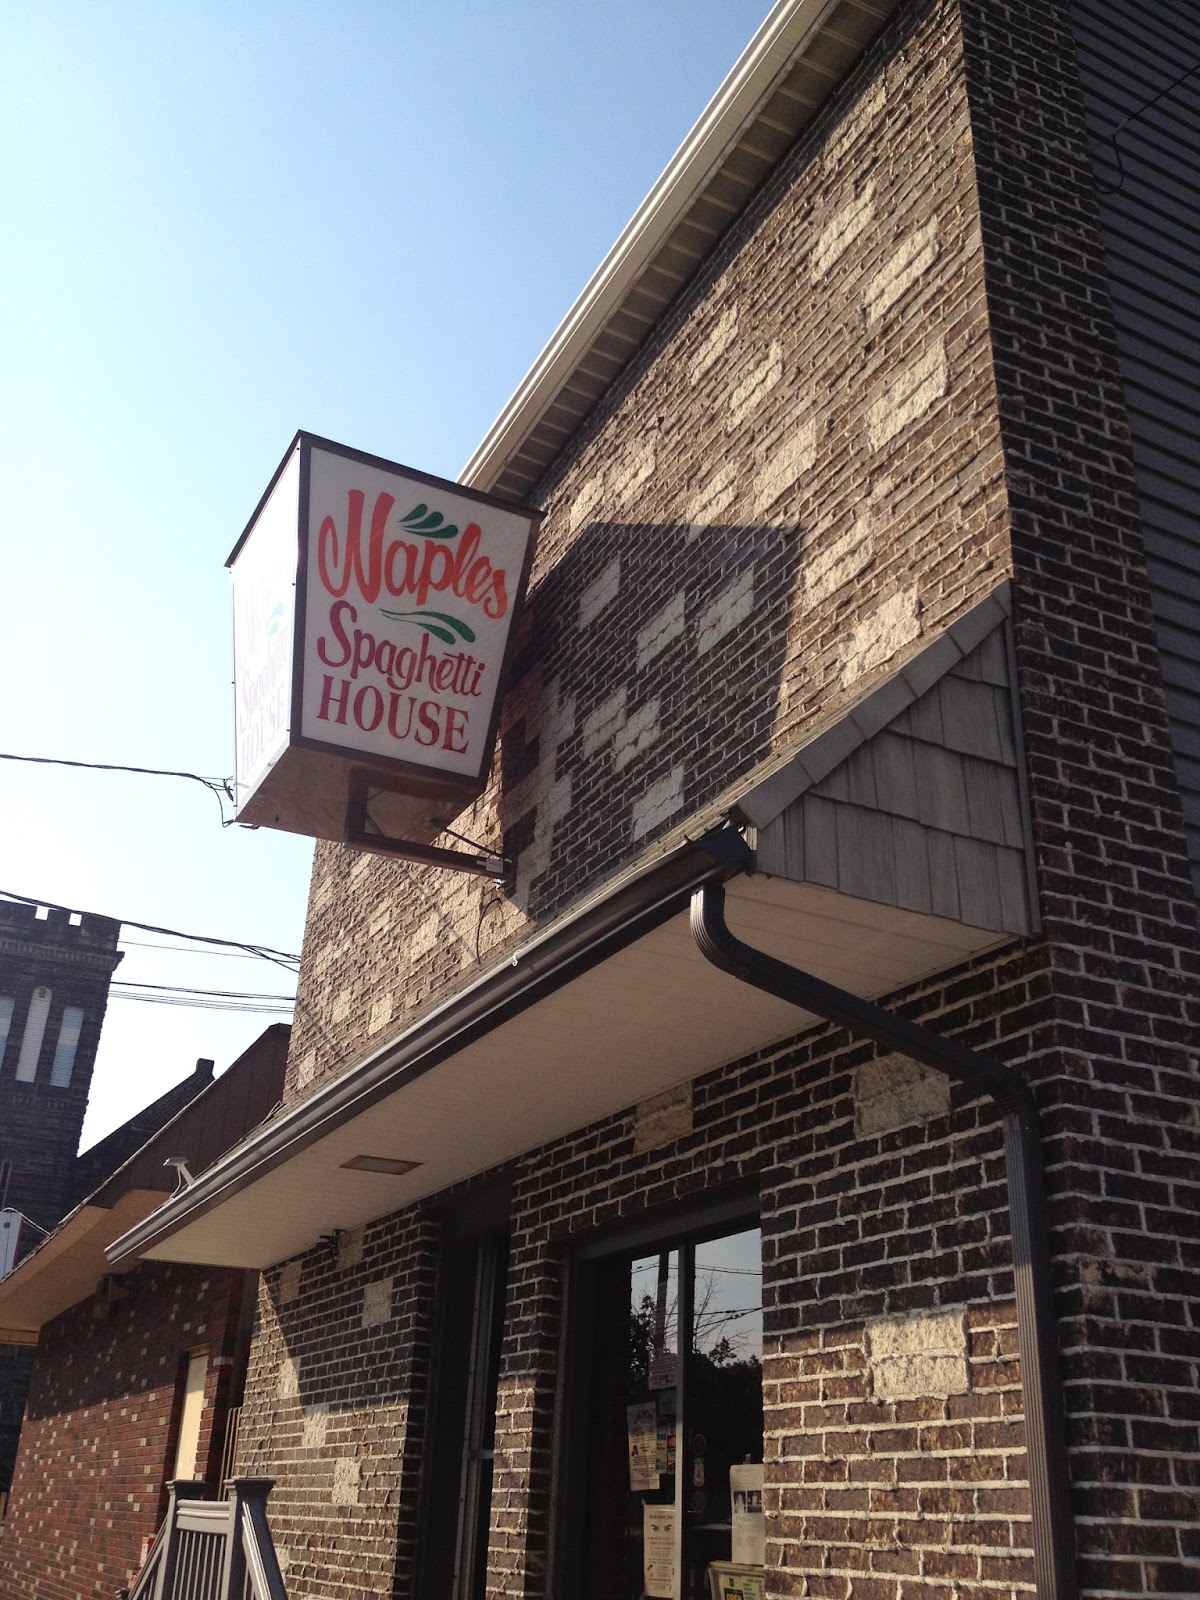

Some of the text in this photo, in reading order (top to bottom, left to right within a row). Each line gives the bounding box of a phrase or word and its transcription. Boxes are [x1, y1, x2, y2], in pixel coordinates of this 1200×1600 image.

[318, 489, 508, 619] Naples
[317, 600, 486, 697] Spaghetti
[316, 674, 470, 755] HOUSE
